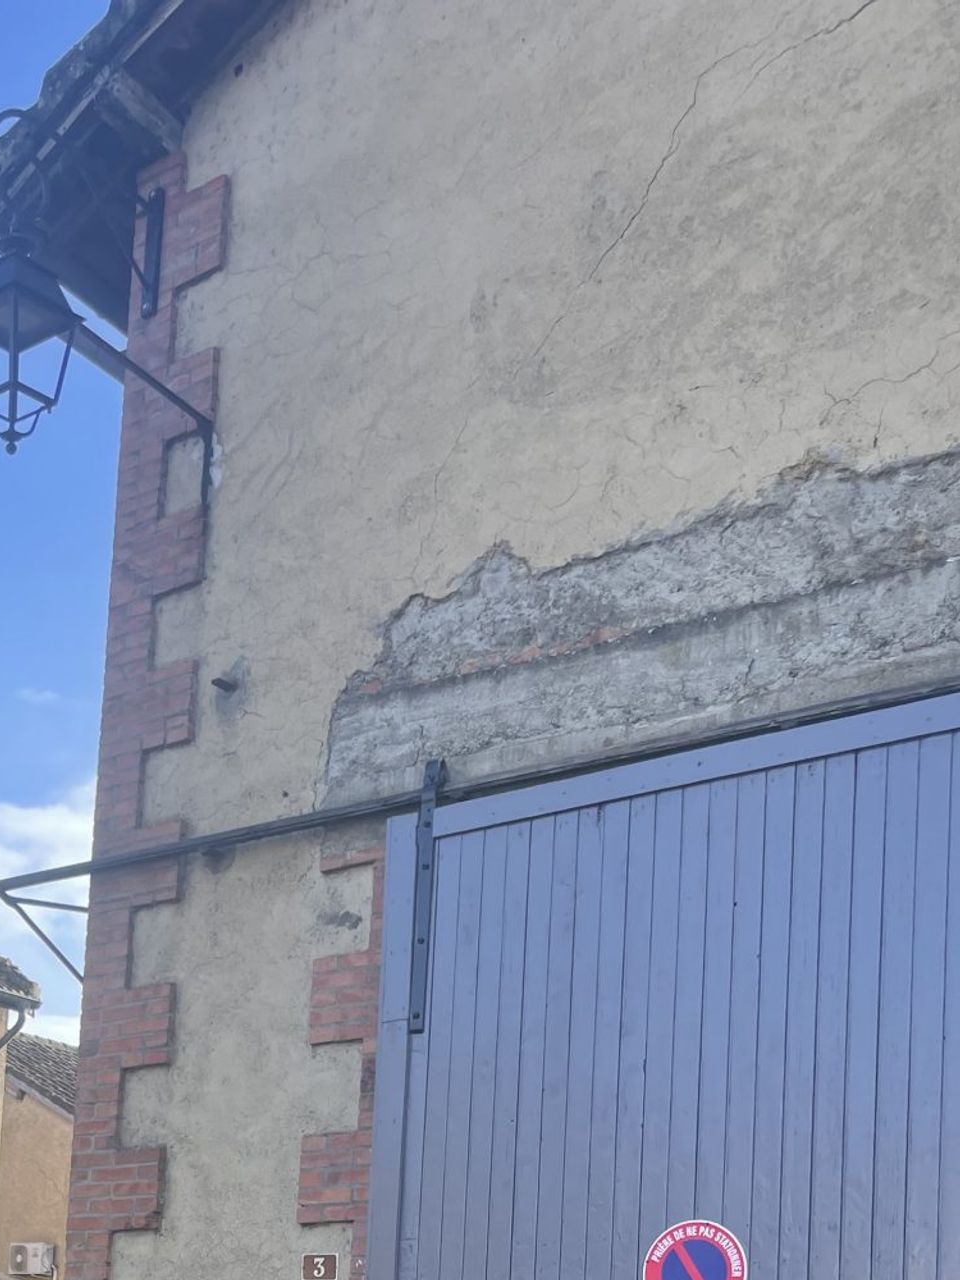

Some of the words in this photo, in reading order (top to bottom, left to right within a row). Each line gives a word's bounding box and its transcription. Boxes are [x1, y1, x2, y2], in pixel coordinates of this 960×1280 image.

[313, 1257, 325, 1278] 3
[651, 1234, 674, 1263] PRIÈRE
[673, 1228, 685, 1241] DE
[686, 1225, 697, 1236] NE
[698, 1225, 716, 1238] PAS
[714, 1231, 742, 1278] STATIONNER
